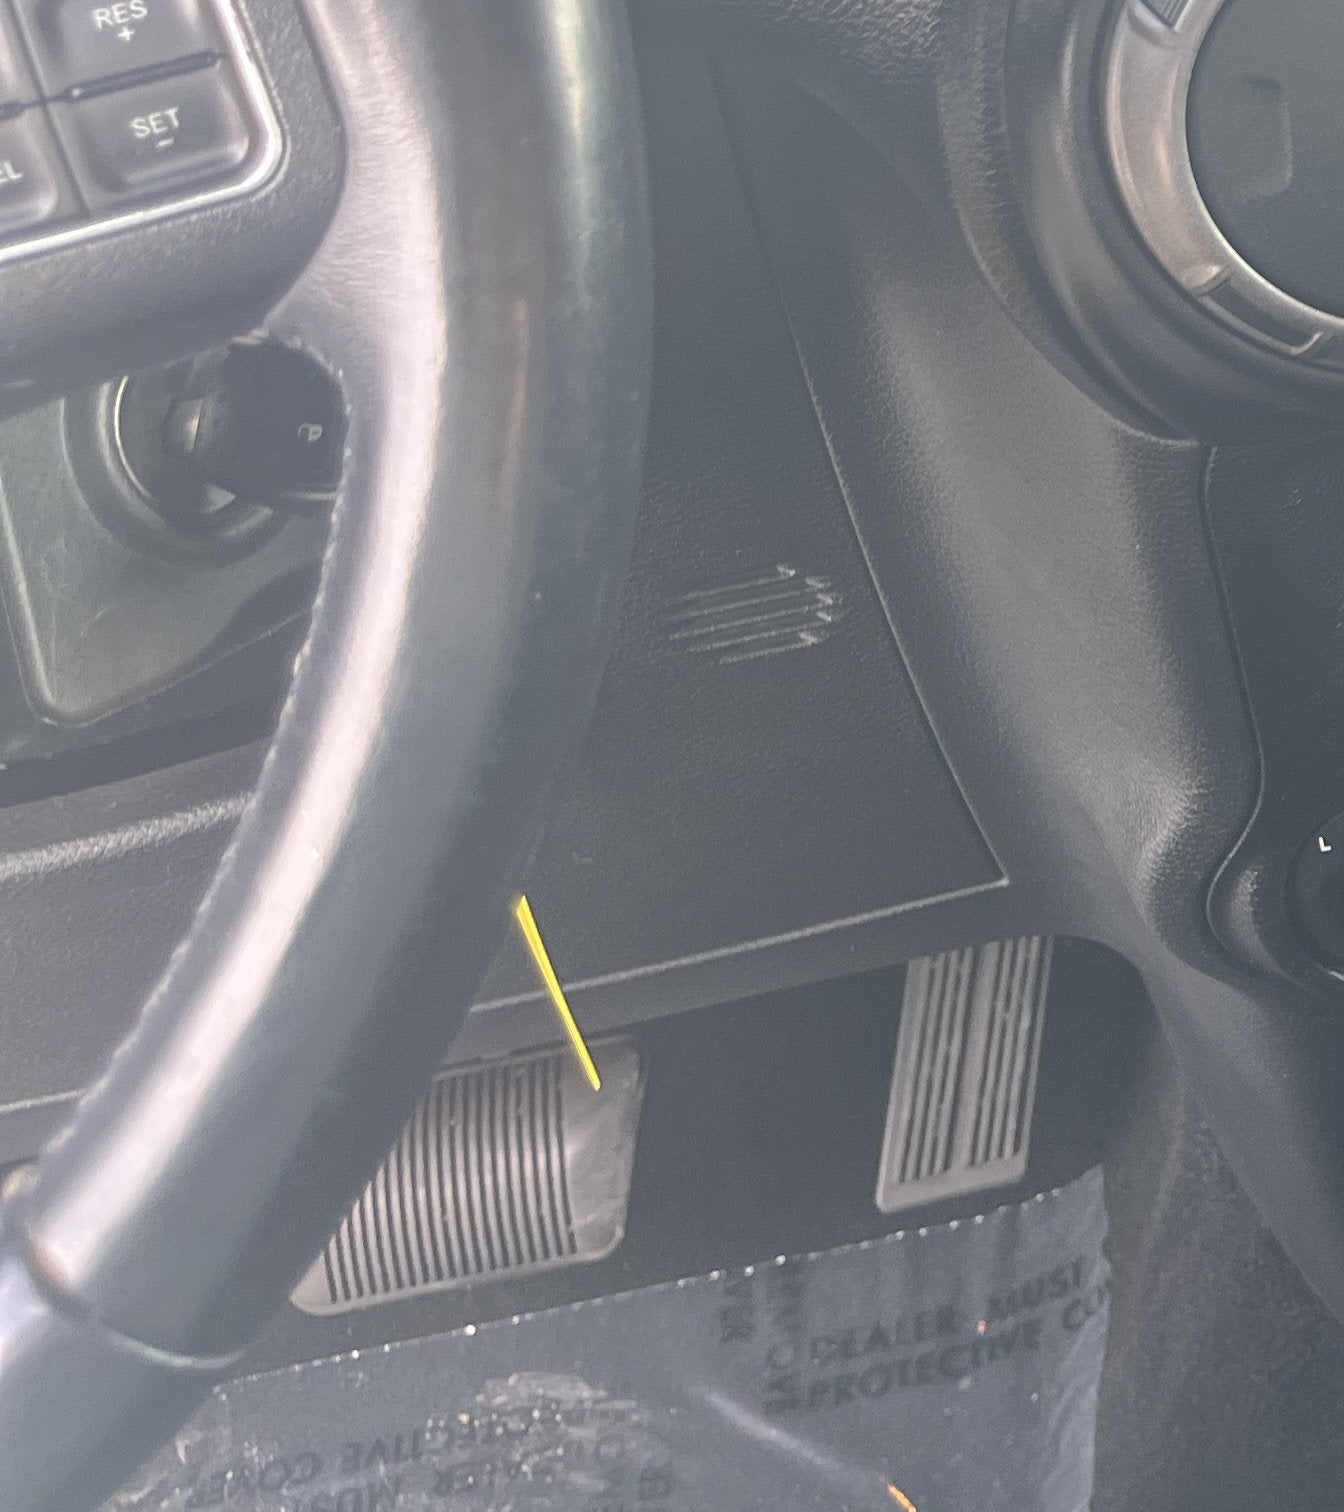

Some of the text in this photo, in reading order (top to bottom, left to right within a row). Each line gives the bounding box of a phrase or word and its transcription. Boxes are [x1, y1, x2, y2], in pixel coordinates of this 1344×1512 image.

[92, 0, 148, 29] RES
[129, 106, 181, 139] SET
[1319, 837, 1331, 851] L
